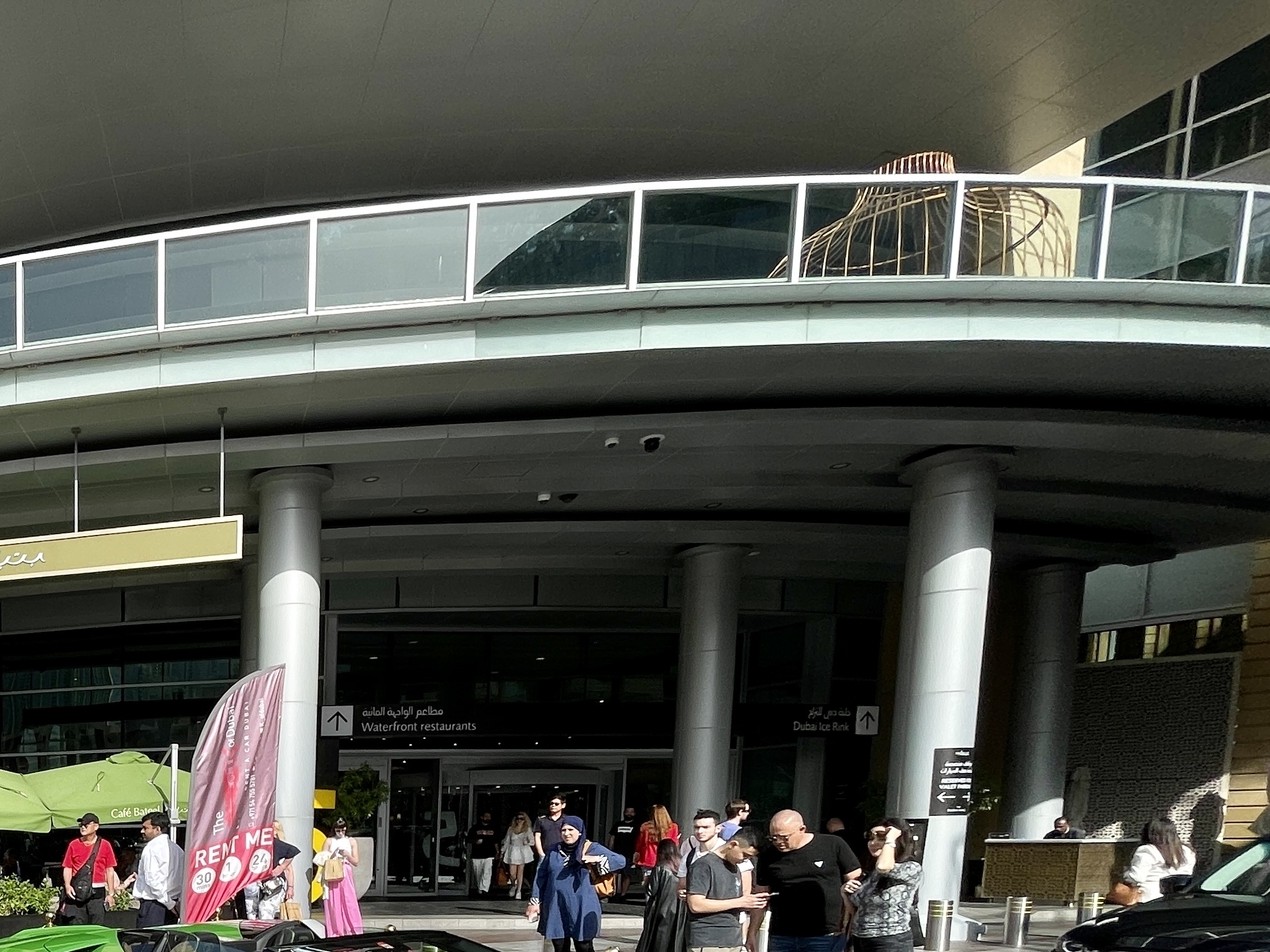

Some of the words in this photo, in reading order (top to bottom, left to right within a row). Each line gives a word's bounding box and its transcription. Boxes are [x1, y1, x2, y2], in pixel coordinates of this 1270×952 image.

[243, 701, 251, 730] DUBAI
[415, 706, 444, 719] مطاعم
[361, 721, 417, 733] Waterfront
[420, 722, 477, 732] restaurants
[793, 720, 818, 731] Dubai
[819, 721, 831, 731] Ice
[832, 721, 850, 731] Rink
[213, 810, 225, 836] The
[226, 704, 236, 738] Dubai
[111, 807, 132, 819] Café
[246, 826, 274, 850] ME
[252, 853, 268, 866] 24
[226, 861, 231, 872] 1
[196, 871, 212, 886] 30
